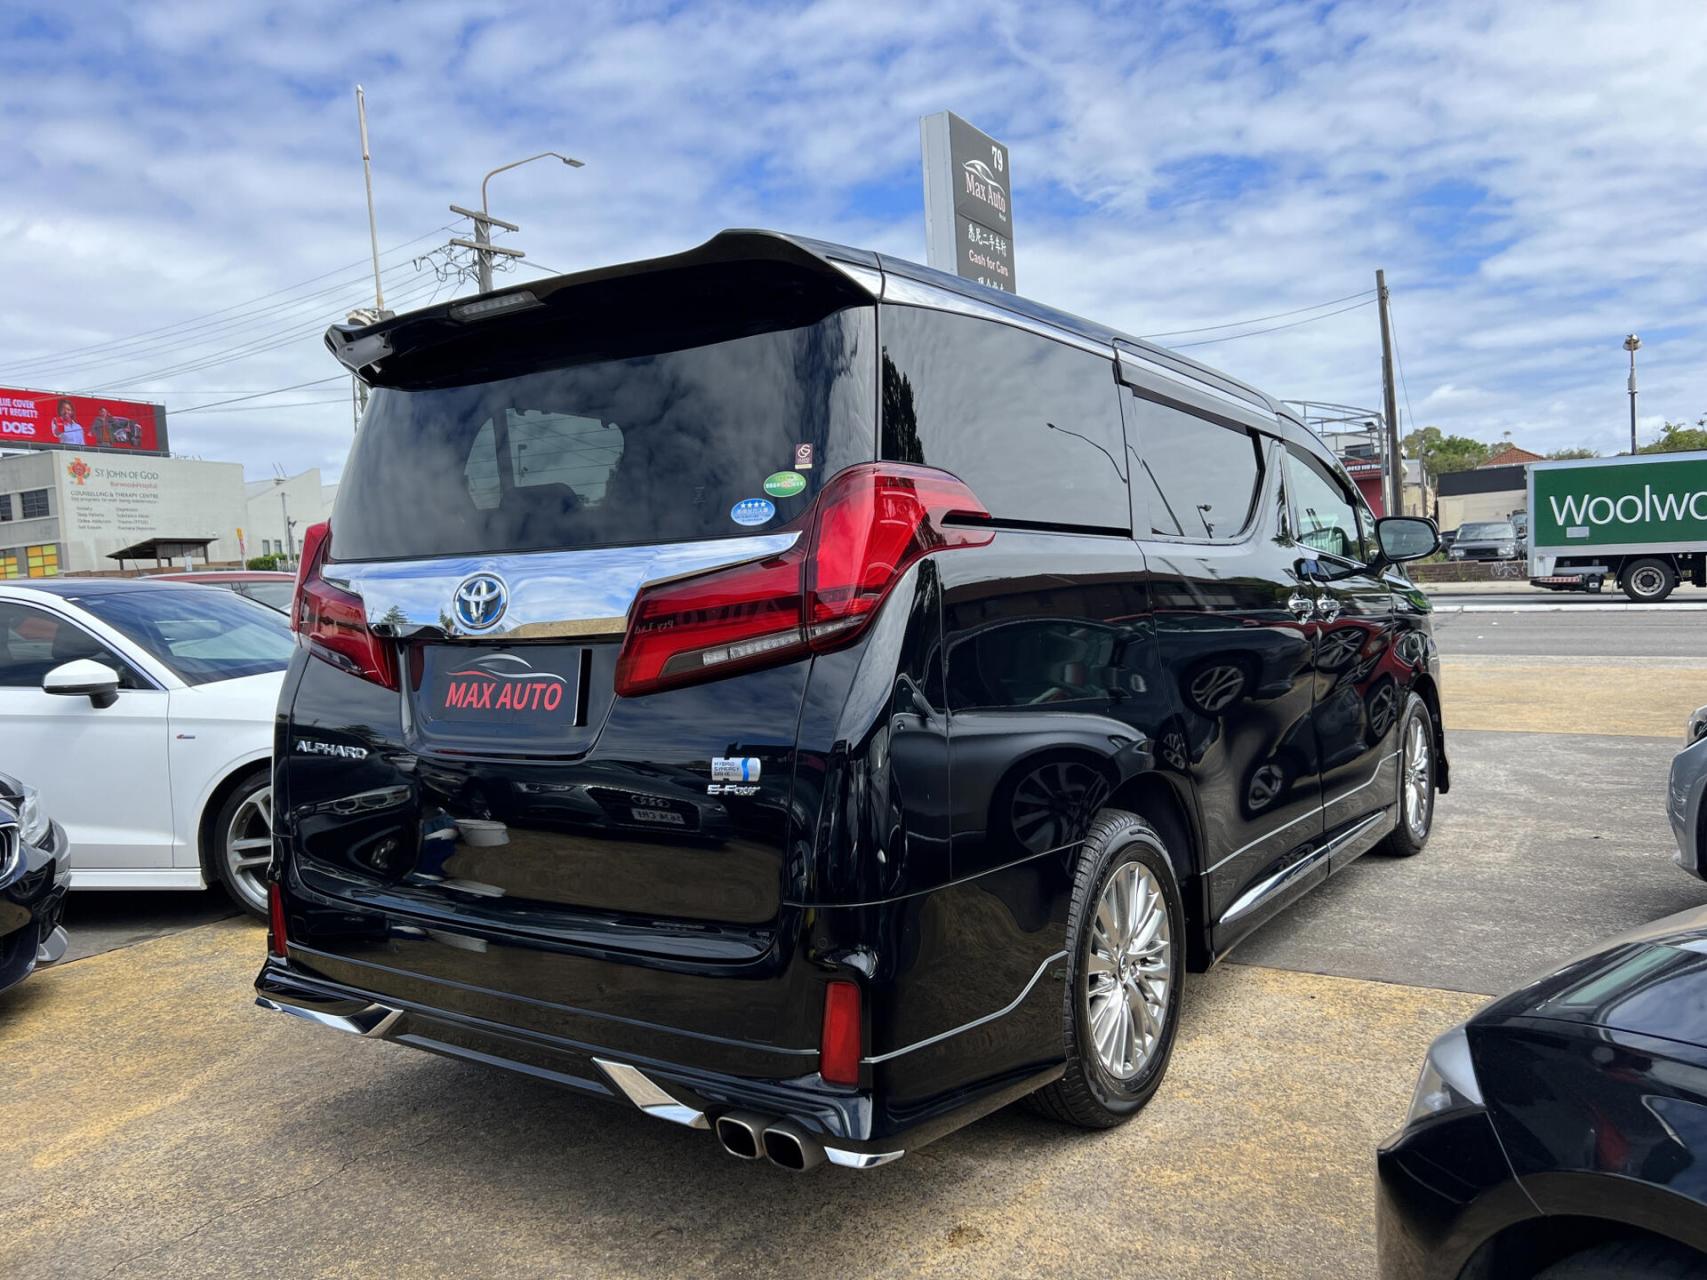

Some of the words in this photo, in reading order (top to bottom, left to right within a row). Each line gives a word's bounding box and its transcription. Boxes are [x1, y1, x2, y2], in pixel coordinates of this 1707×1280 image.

[991, 145, 1003, 172] 79
[965, 171, 986, 201] Max
[987, 184, 1006, 213] Auto
[969, 249, 986, 267] Cash
[986, 256, 996, 271] for
[996, 261, 1009, 277] Cars
[12, 398, 35, 409] COVER
[2, 420, 36, 435] DOES
[95, 468, 104, 477] ST
[106, 468, 127, 479] JOHN
[128, 471, 139, 480] OF
[140, 470, 159, 480] GOD
[445, 682, 497, 709] MAX
[495, 682, 563, 711] AUTO
[296, 740, 369, 760] ALPHARD
[707, 784, 761, 796] E-Four
